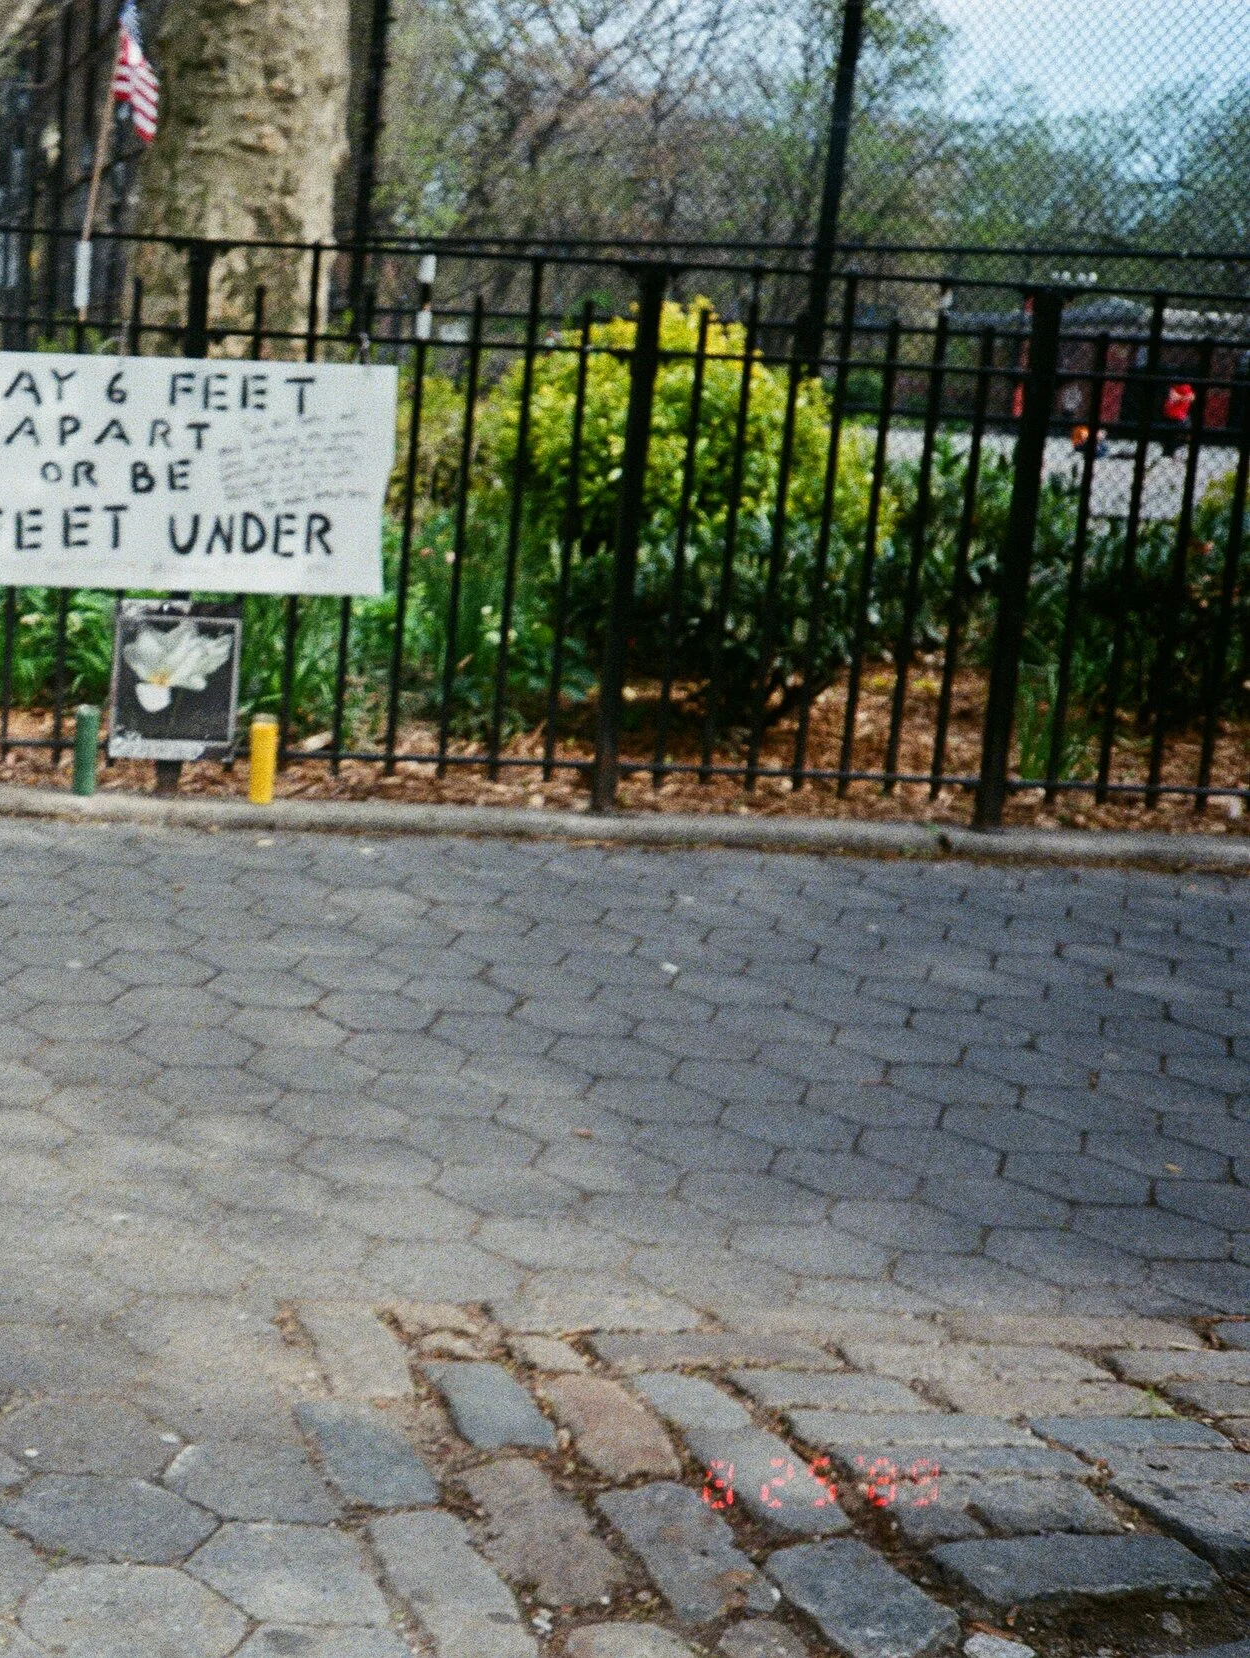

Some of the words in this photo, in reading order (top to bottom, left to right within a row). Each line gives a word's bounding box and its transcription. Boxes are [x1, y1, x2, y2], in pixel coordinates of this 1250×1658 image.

[106, 371, 128, 405] 6
[169, 370, 316, 415] FEET
[4, 414, 212, 452] APART
[41, 461, 98, 489] OR
[131, 459, 192, 494] BE
[168, 511, 334, 558] UNDER
